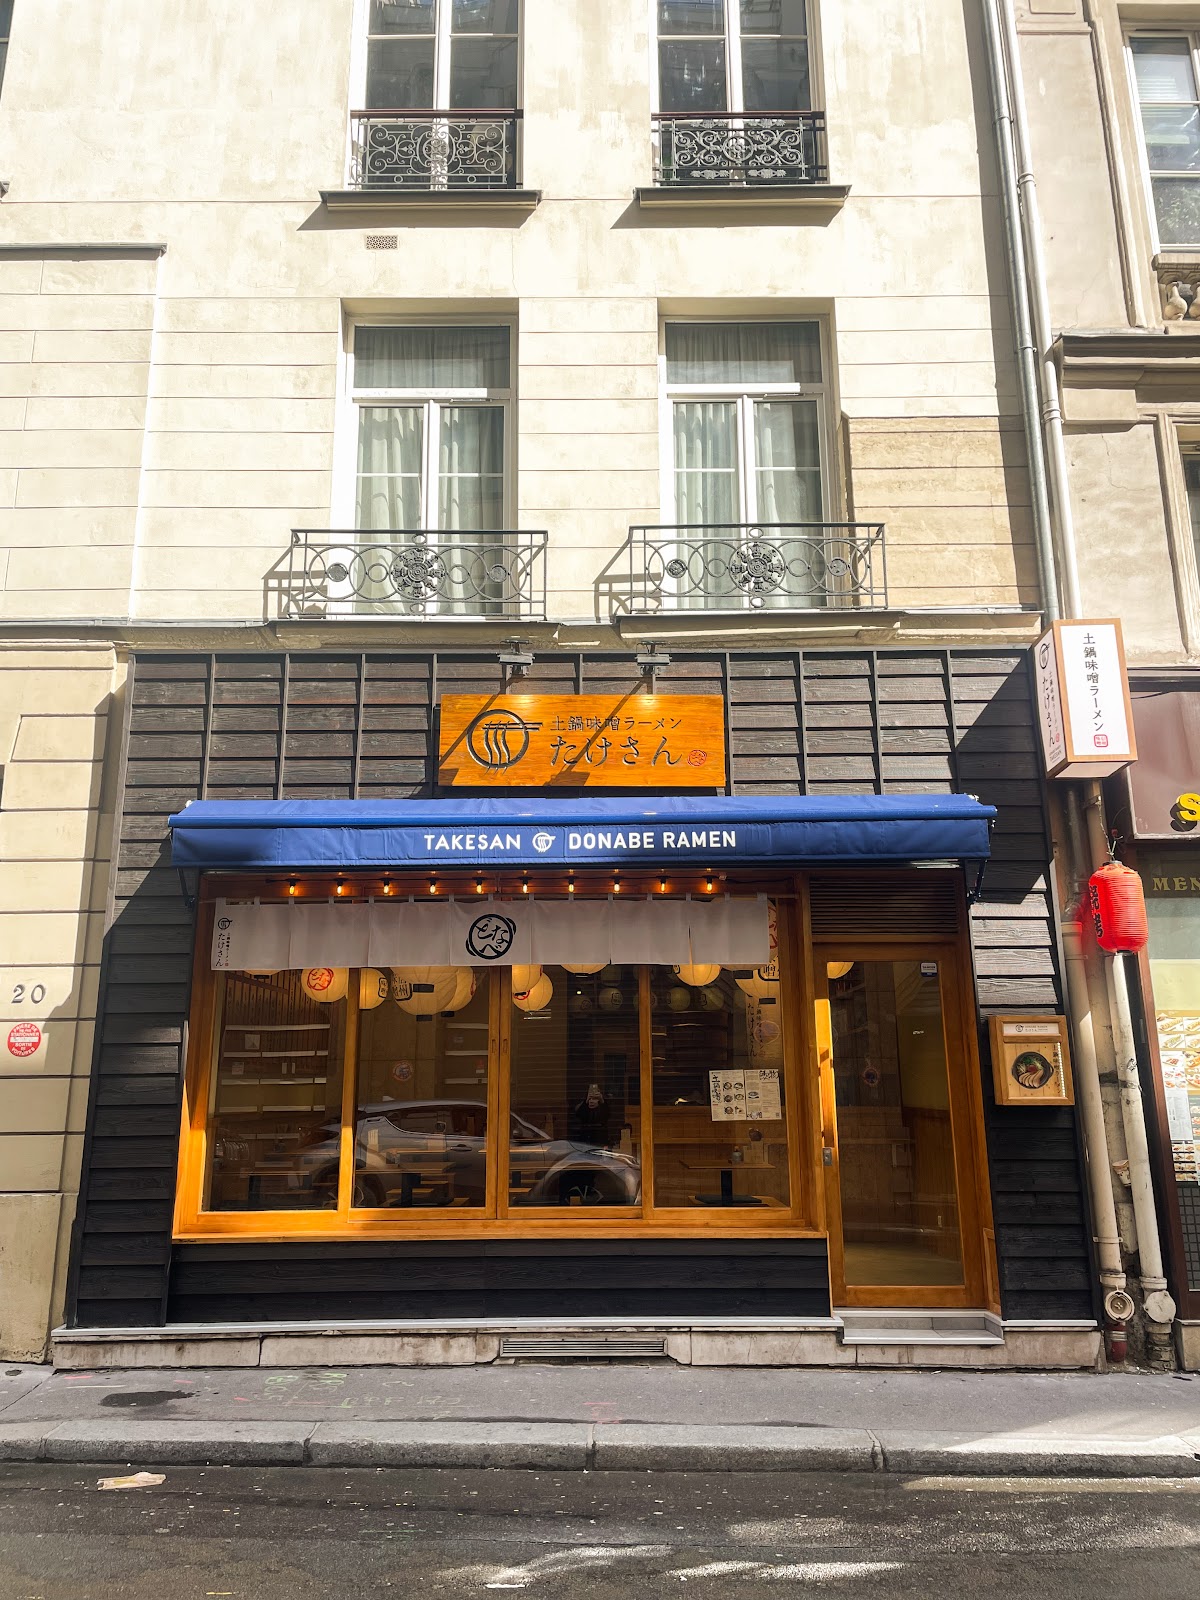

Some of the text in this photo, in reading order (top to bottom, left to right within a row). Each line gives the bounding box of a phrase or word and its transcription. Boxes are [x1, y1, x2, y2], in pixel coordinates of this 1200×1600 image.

[1083, 632, 1104, 732] 土鍋味噌ラーメン
[550, 715, 682, 732] 土鍋味噌ラーメン
[550, 735, 683, 768] たけさん
[423, 830, 737, 850] TAKESAN DONABE RAMEN
[11, 984, 46, 1004] 20
